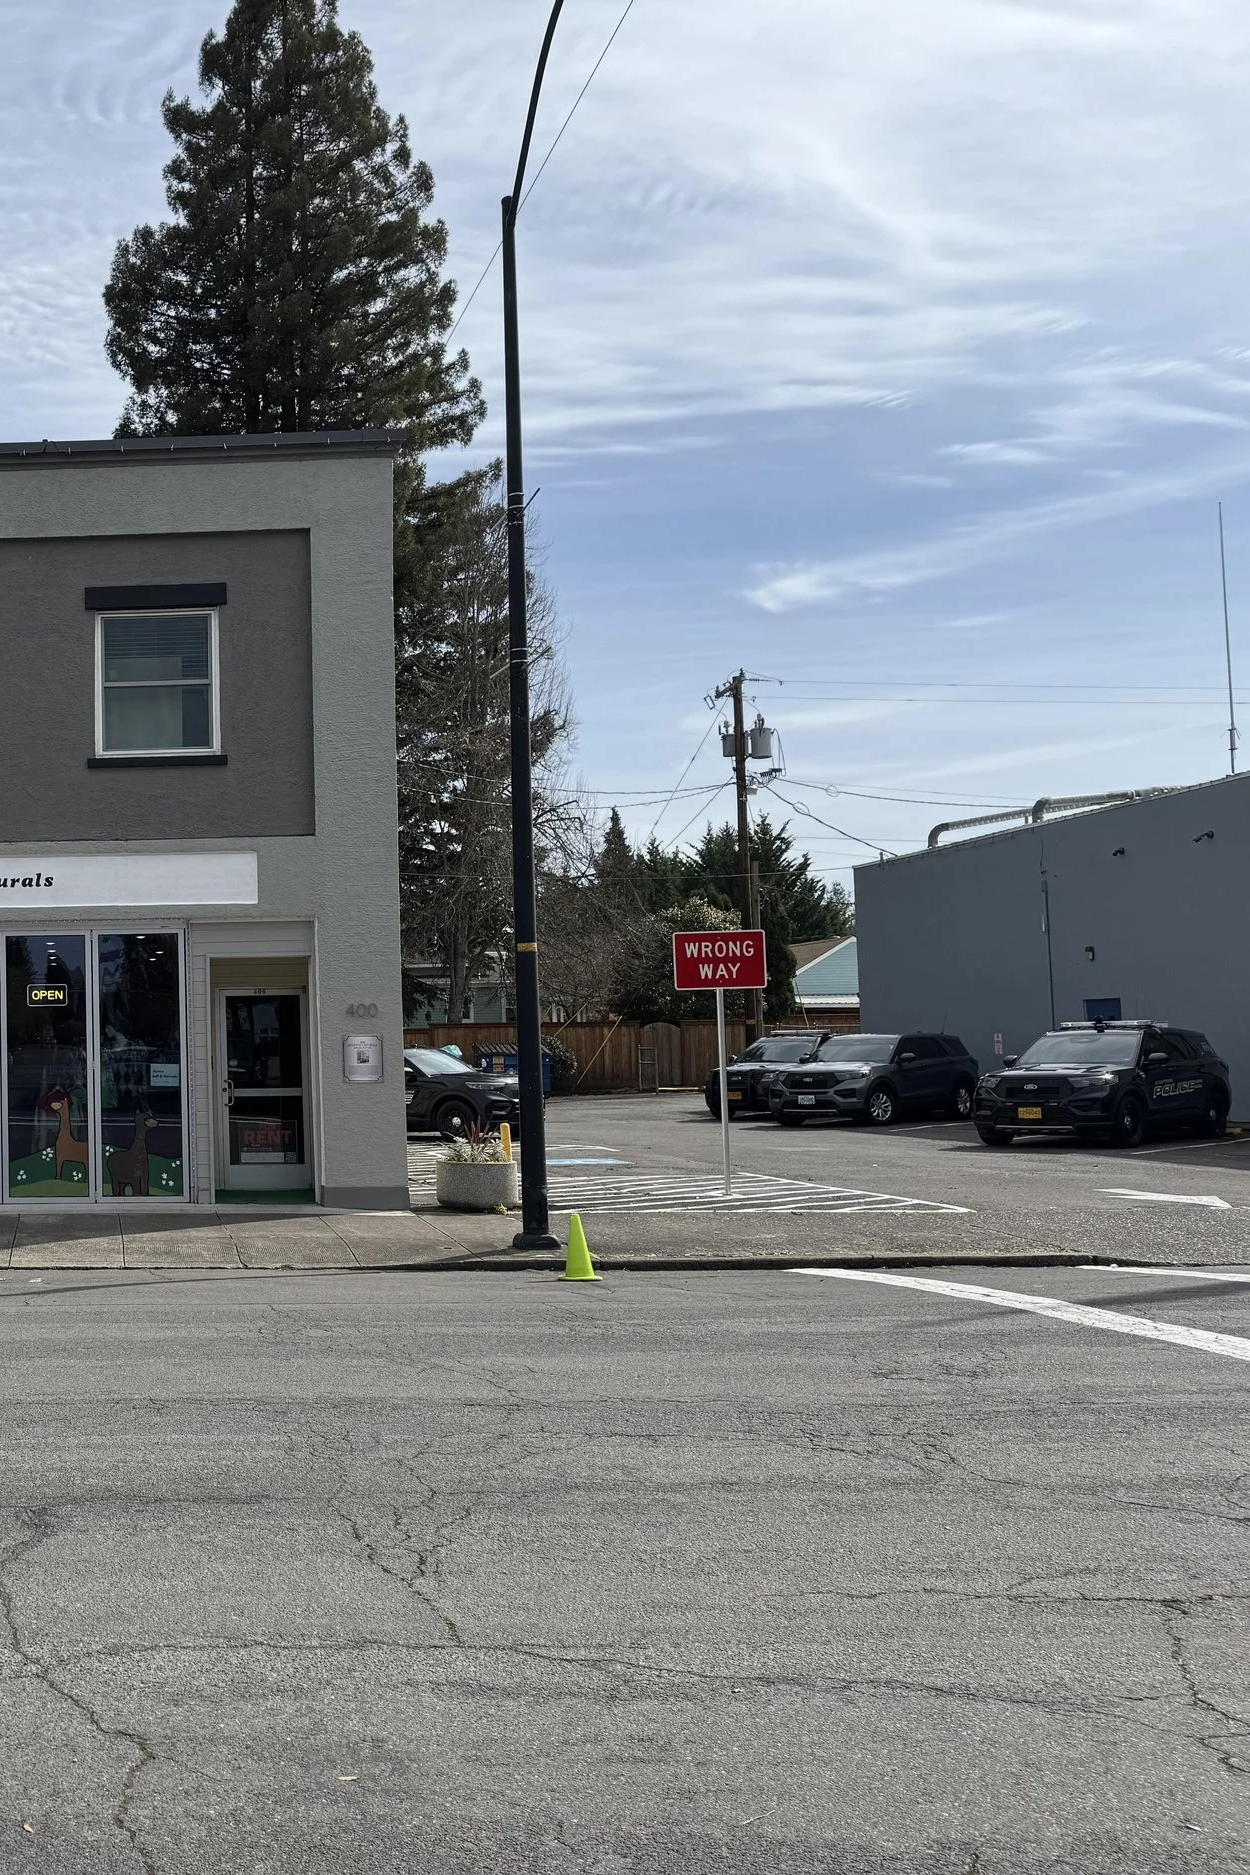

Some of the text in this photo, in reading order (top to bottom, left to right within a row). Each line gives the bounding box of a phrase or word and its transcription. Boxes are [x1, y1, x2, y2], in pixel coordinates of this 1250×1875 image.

[684, 940, 755, 959] WRONG
[698, 962, 741, 980] WAY
[31, 990, 64, 1000] OPEN
[345, 1003, 378, 1018] 400
[1153, 1081, 1196, 1099] POLICE
[244, 1130, 292, 1145] RENT
